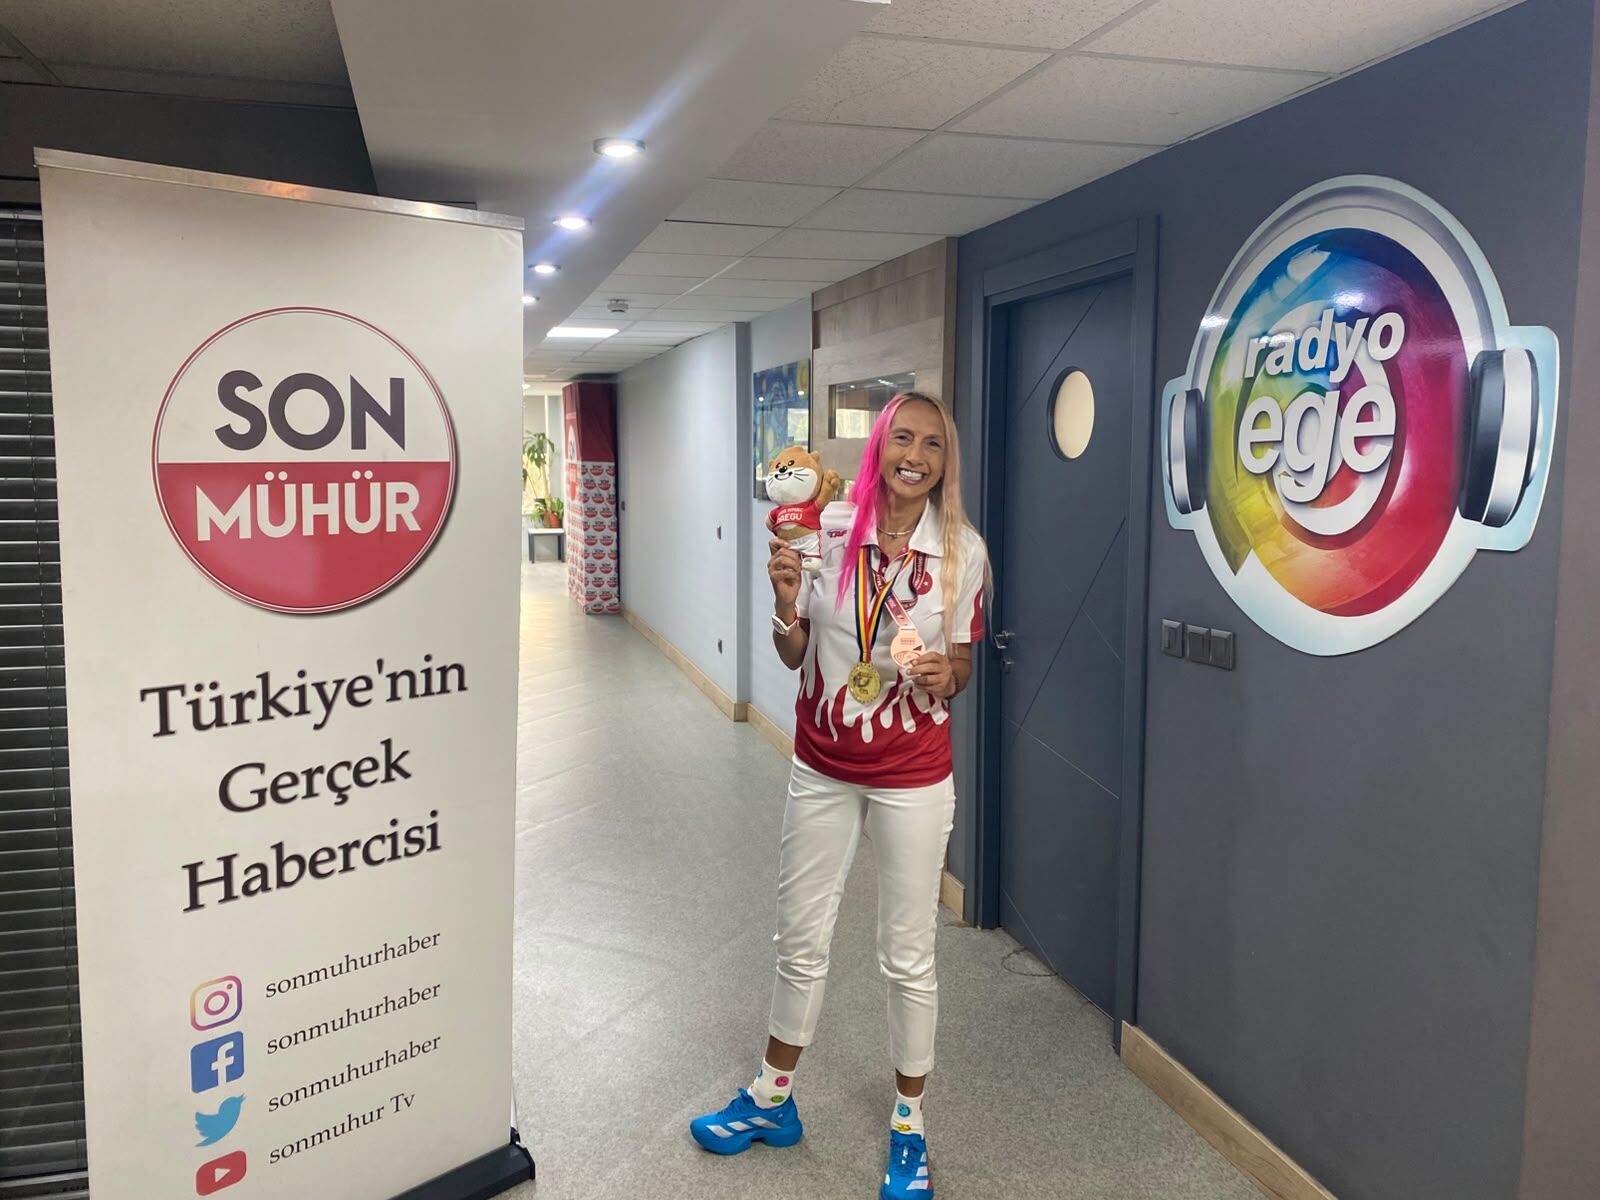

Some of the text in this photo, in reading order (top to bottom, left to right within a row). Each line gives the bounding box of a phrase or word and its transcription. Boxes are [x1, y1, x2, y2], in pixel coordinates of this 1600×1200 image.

[1244, 308, 1405, 384] radyo
[214, 369, 406, 452] SON
[1238, 385, 1396, 503] ege
[195, 470, 422, 541] MÜHÜR
[139, 653, 468, 738] Türkiye'nin
[217, 737, 412, 813] Gerçek
[181, 809, 442, 914] Habercisi
[265, 932, 441, 998] sonmuhurhaber
[266, 983, 441, 1055] sonmuhurhaber
[268, 1036, 441, 1113] sonmuhurhaber
[269, 1093, 416, 1165] sonmuhur Tv
